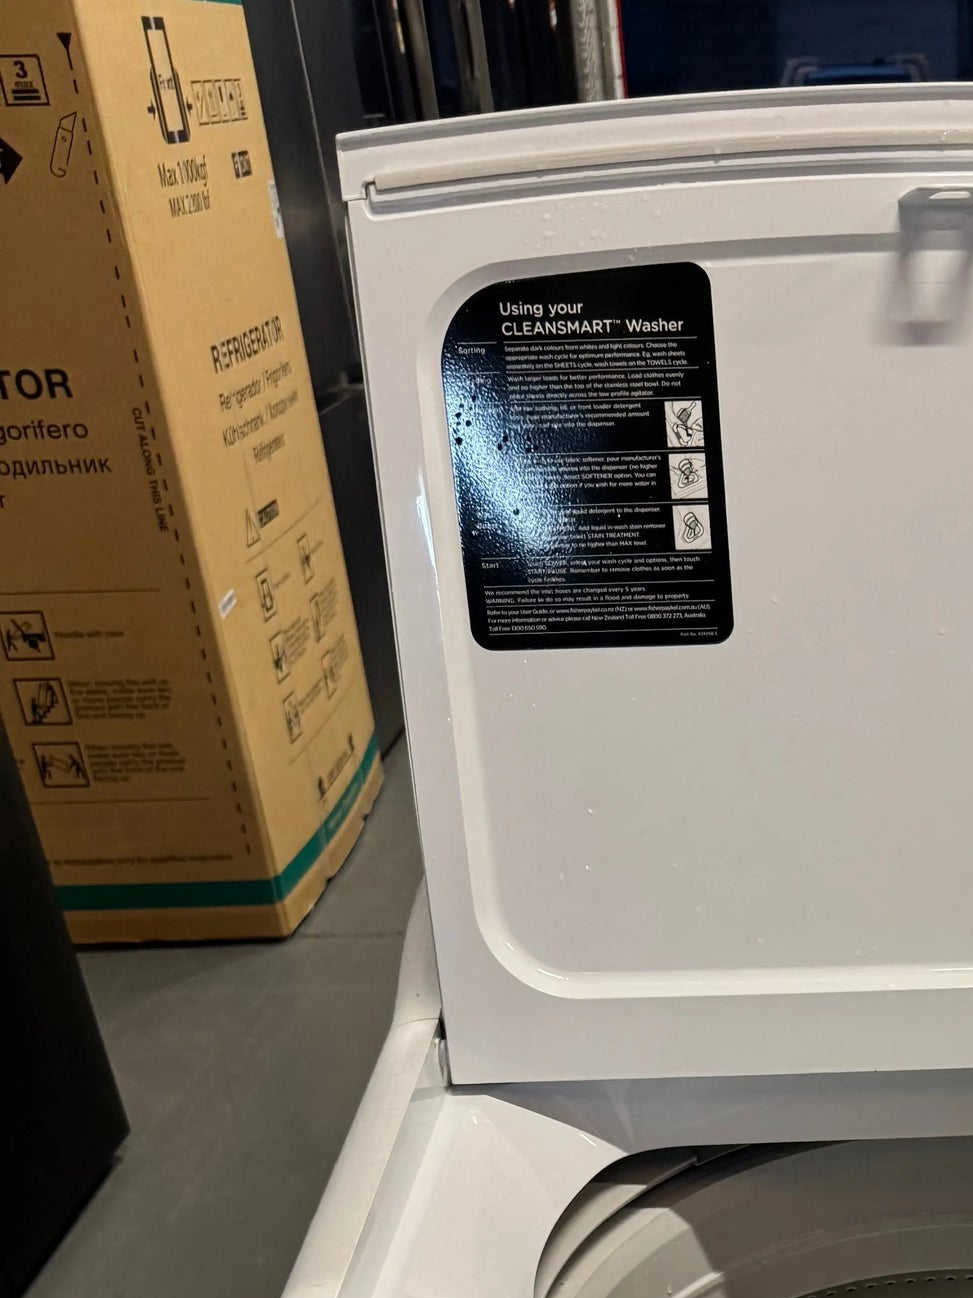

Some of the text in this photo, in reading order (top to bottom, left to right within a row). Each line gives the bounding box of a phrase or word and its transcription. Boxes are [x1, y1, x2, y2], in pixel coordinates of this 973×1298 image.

[13, 60, 28, 78] 3
[158, 162, 177, 188] Max
[499, 302, 583, 317] Using your
[625, 318, 684, 333] Washer
[210, 315, 285, 374] REFRIGERATOR
[458, 346, 485, 354] Sorting
[613, 402, 641, 410] detergent
[132, 407, 169, 532] CUT ALONG THIS LINE
